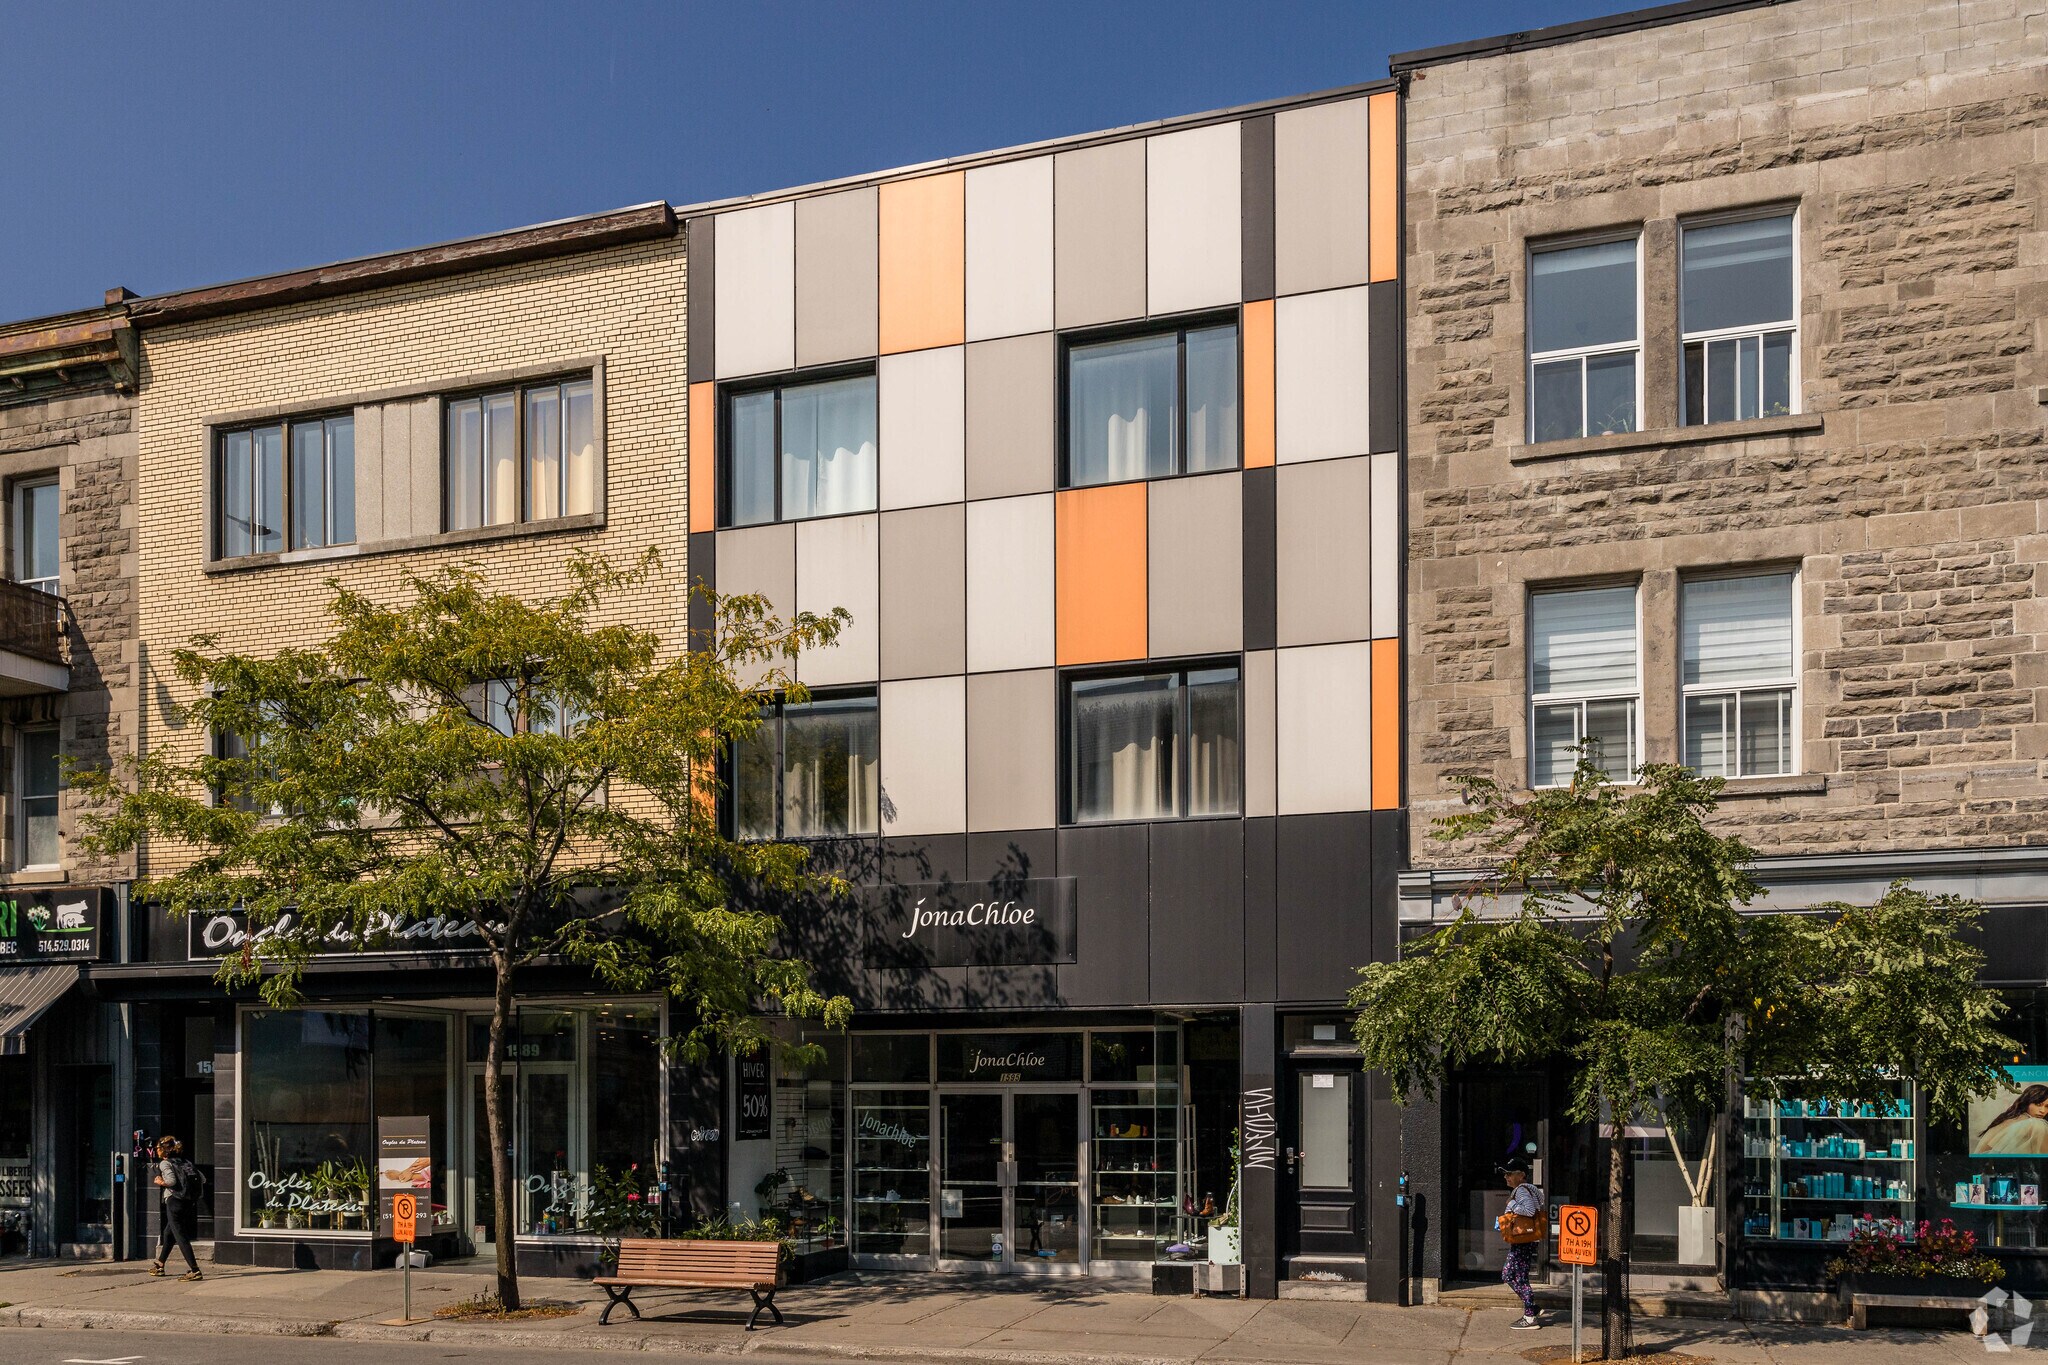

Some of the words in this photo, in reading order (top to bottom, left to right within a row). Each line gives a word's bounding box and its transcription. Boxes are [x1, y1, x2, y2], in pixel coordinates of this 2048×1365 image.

[38, 939, 90, 952] 514.529.0314
[196, 1060, 215, 1073] 15
[743, 1062, 765, 1078] HIVER
[743, 1094, 768, 1118] 50%
[248, 1171, 313, 1194] Ongles
[526, 1174, 598, 1199] Ongles
[266, 1196, 284, 1207] du
[287, 1192, 363, 1211] Plateau
[1566, 1237, 1574, 1246] 7H
[1581, 1239, 1592, 1248] 19H
[1575, 1248, 1582, 1256] AU
